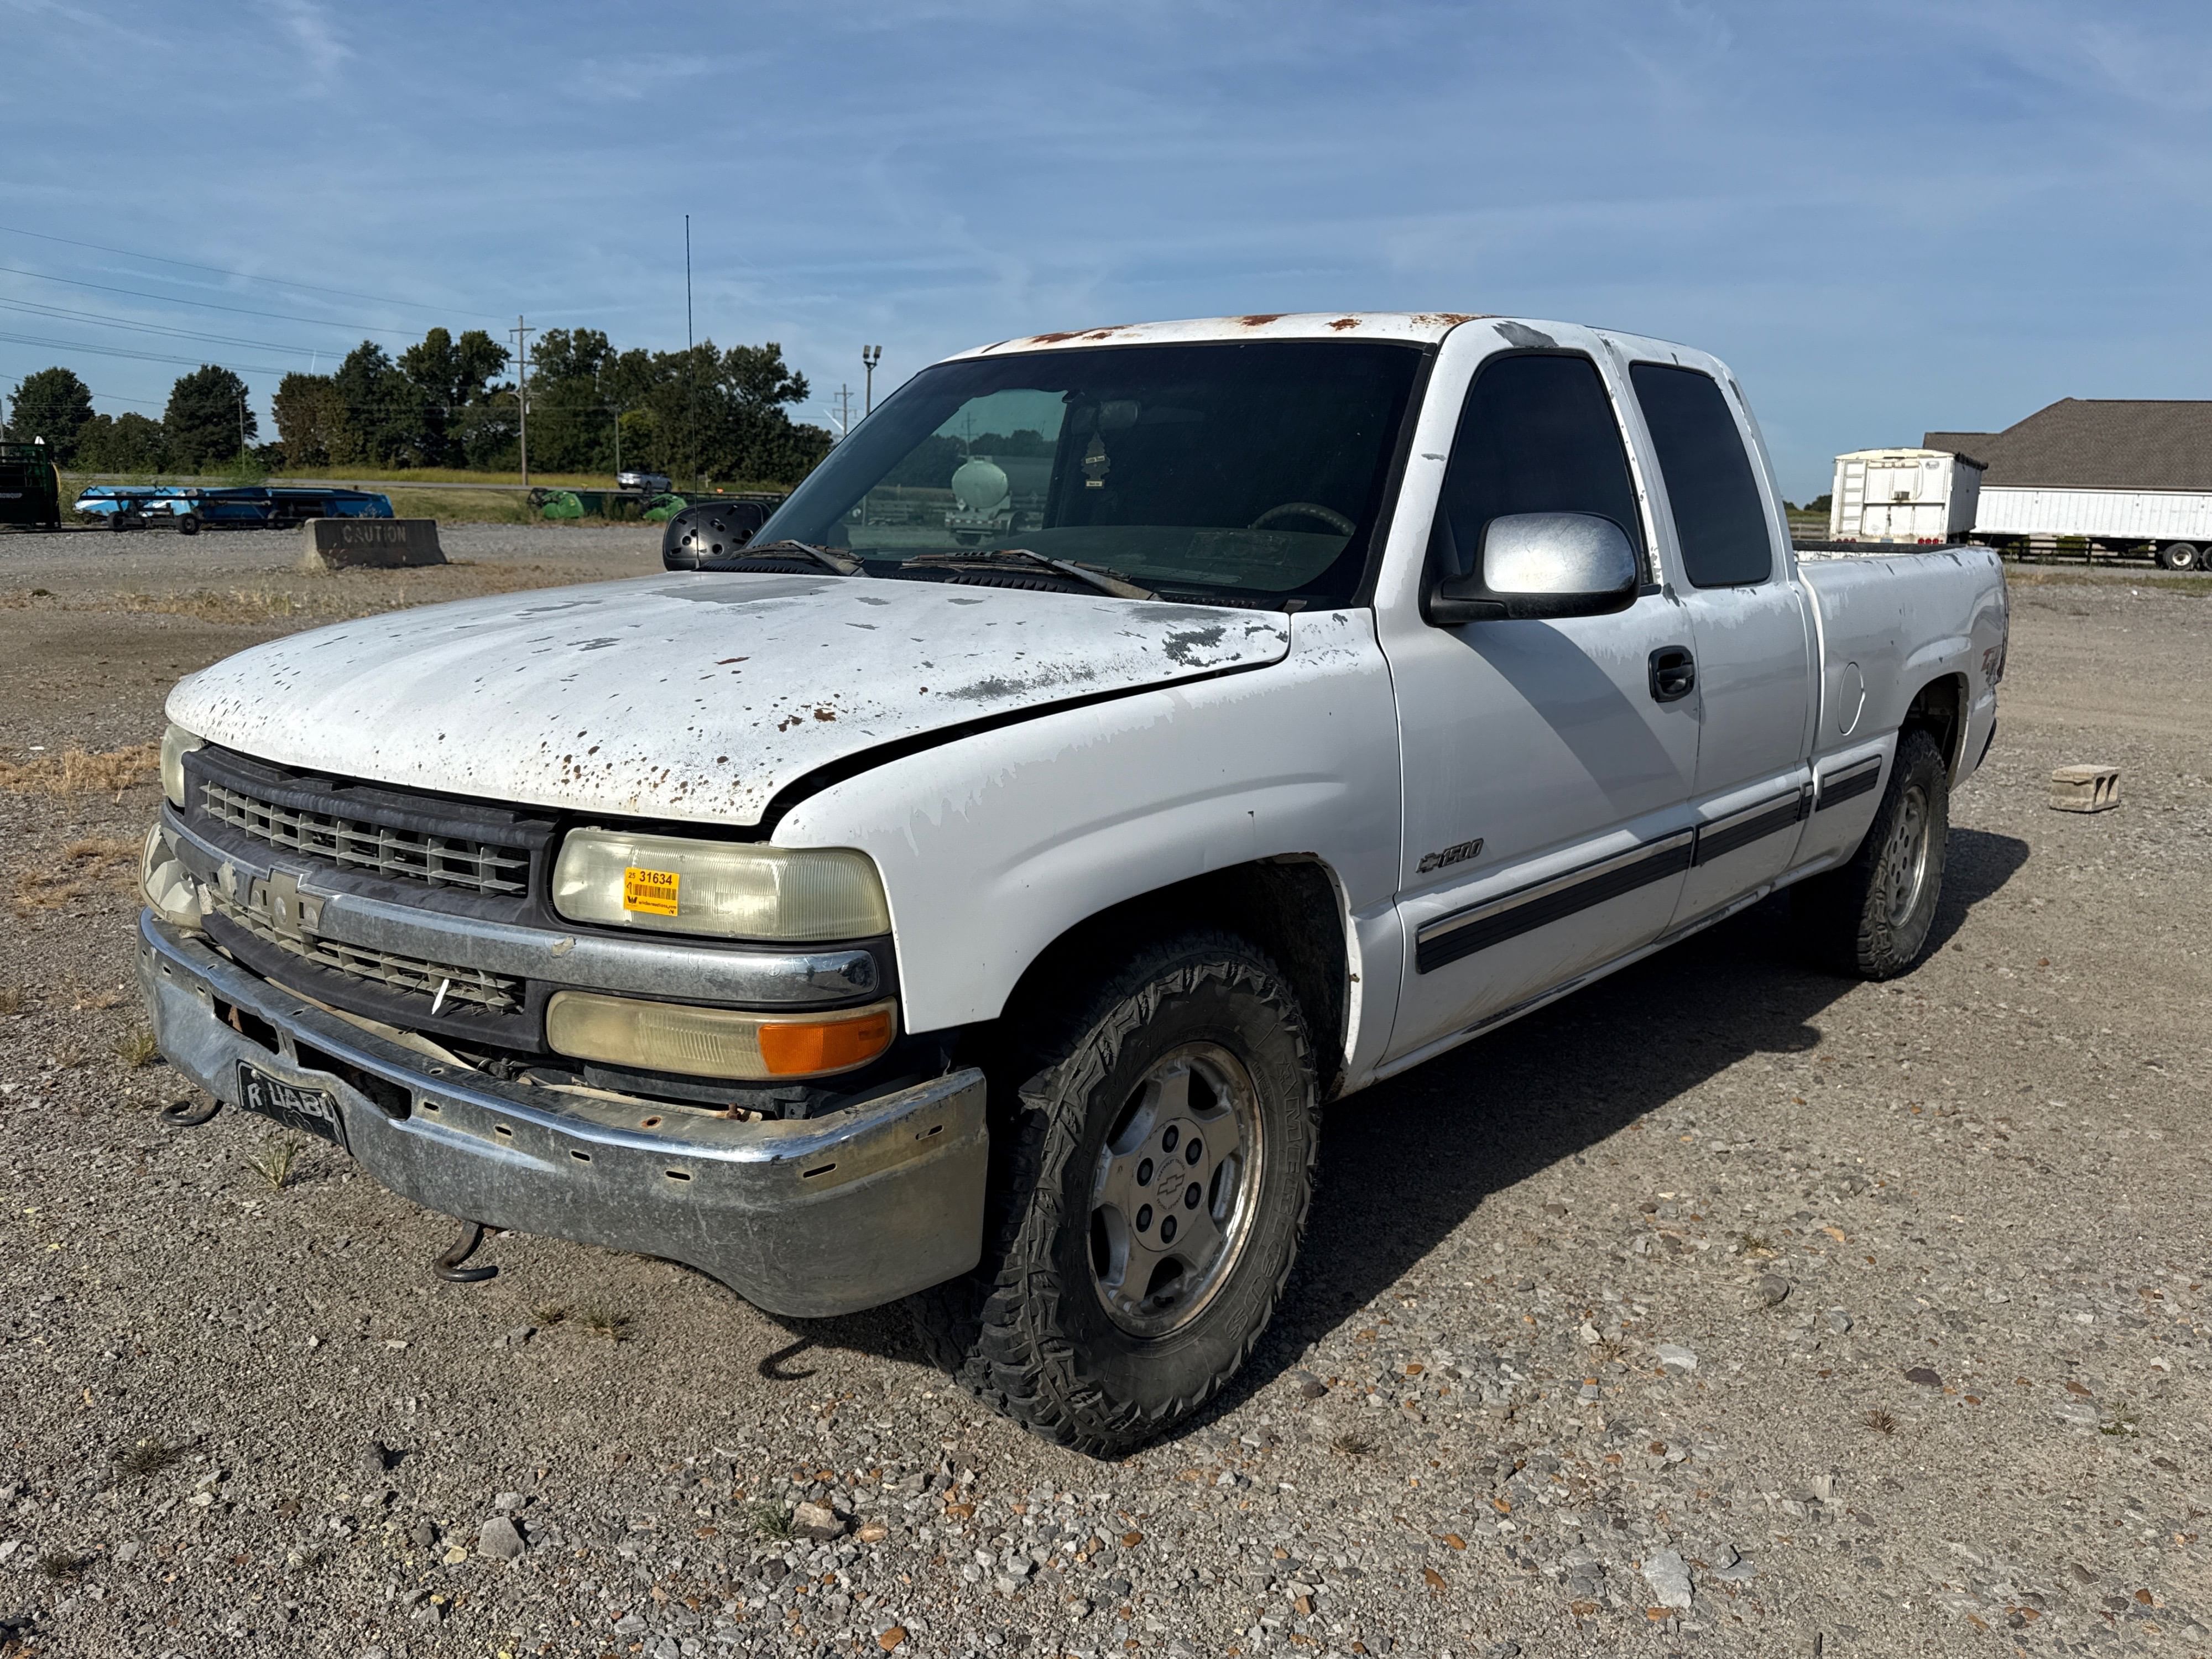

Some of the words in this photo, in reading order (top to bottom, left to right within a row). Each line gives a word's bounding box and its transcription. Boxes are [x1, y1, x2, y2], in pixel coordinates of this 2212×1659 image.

[342, 525, 406, 543] CAUTION
[1441, 838, 1484, 868] 1500
[639, 871, 672, 885] 31634
[1225, 1053, 1305, 1342] AMERICUS
